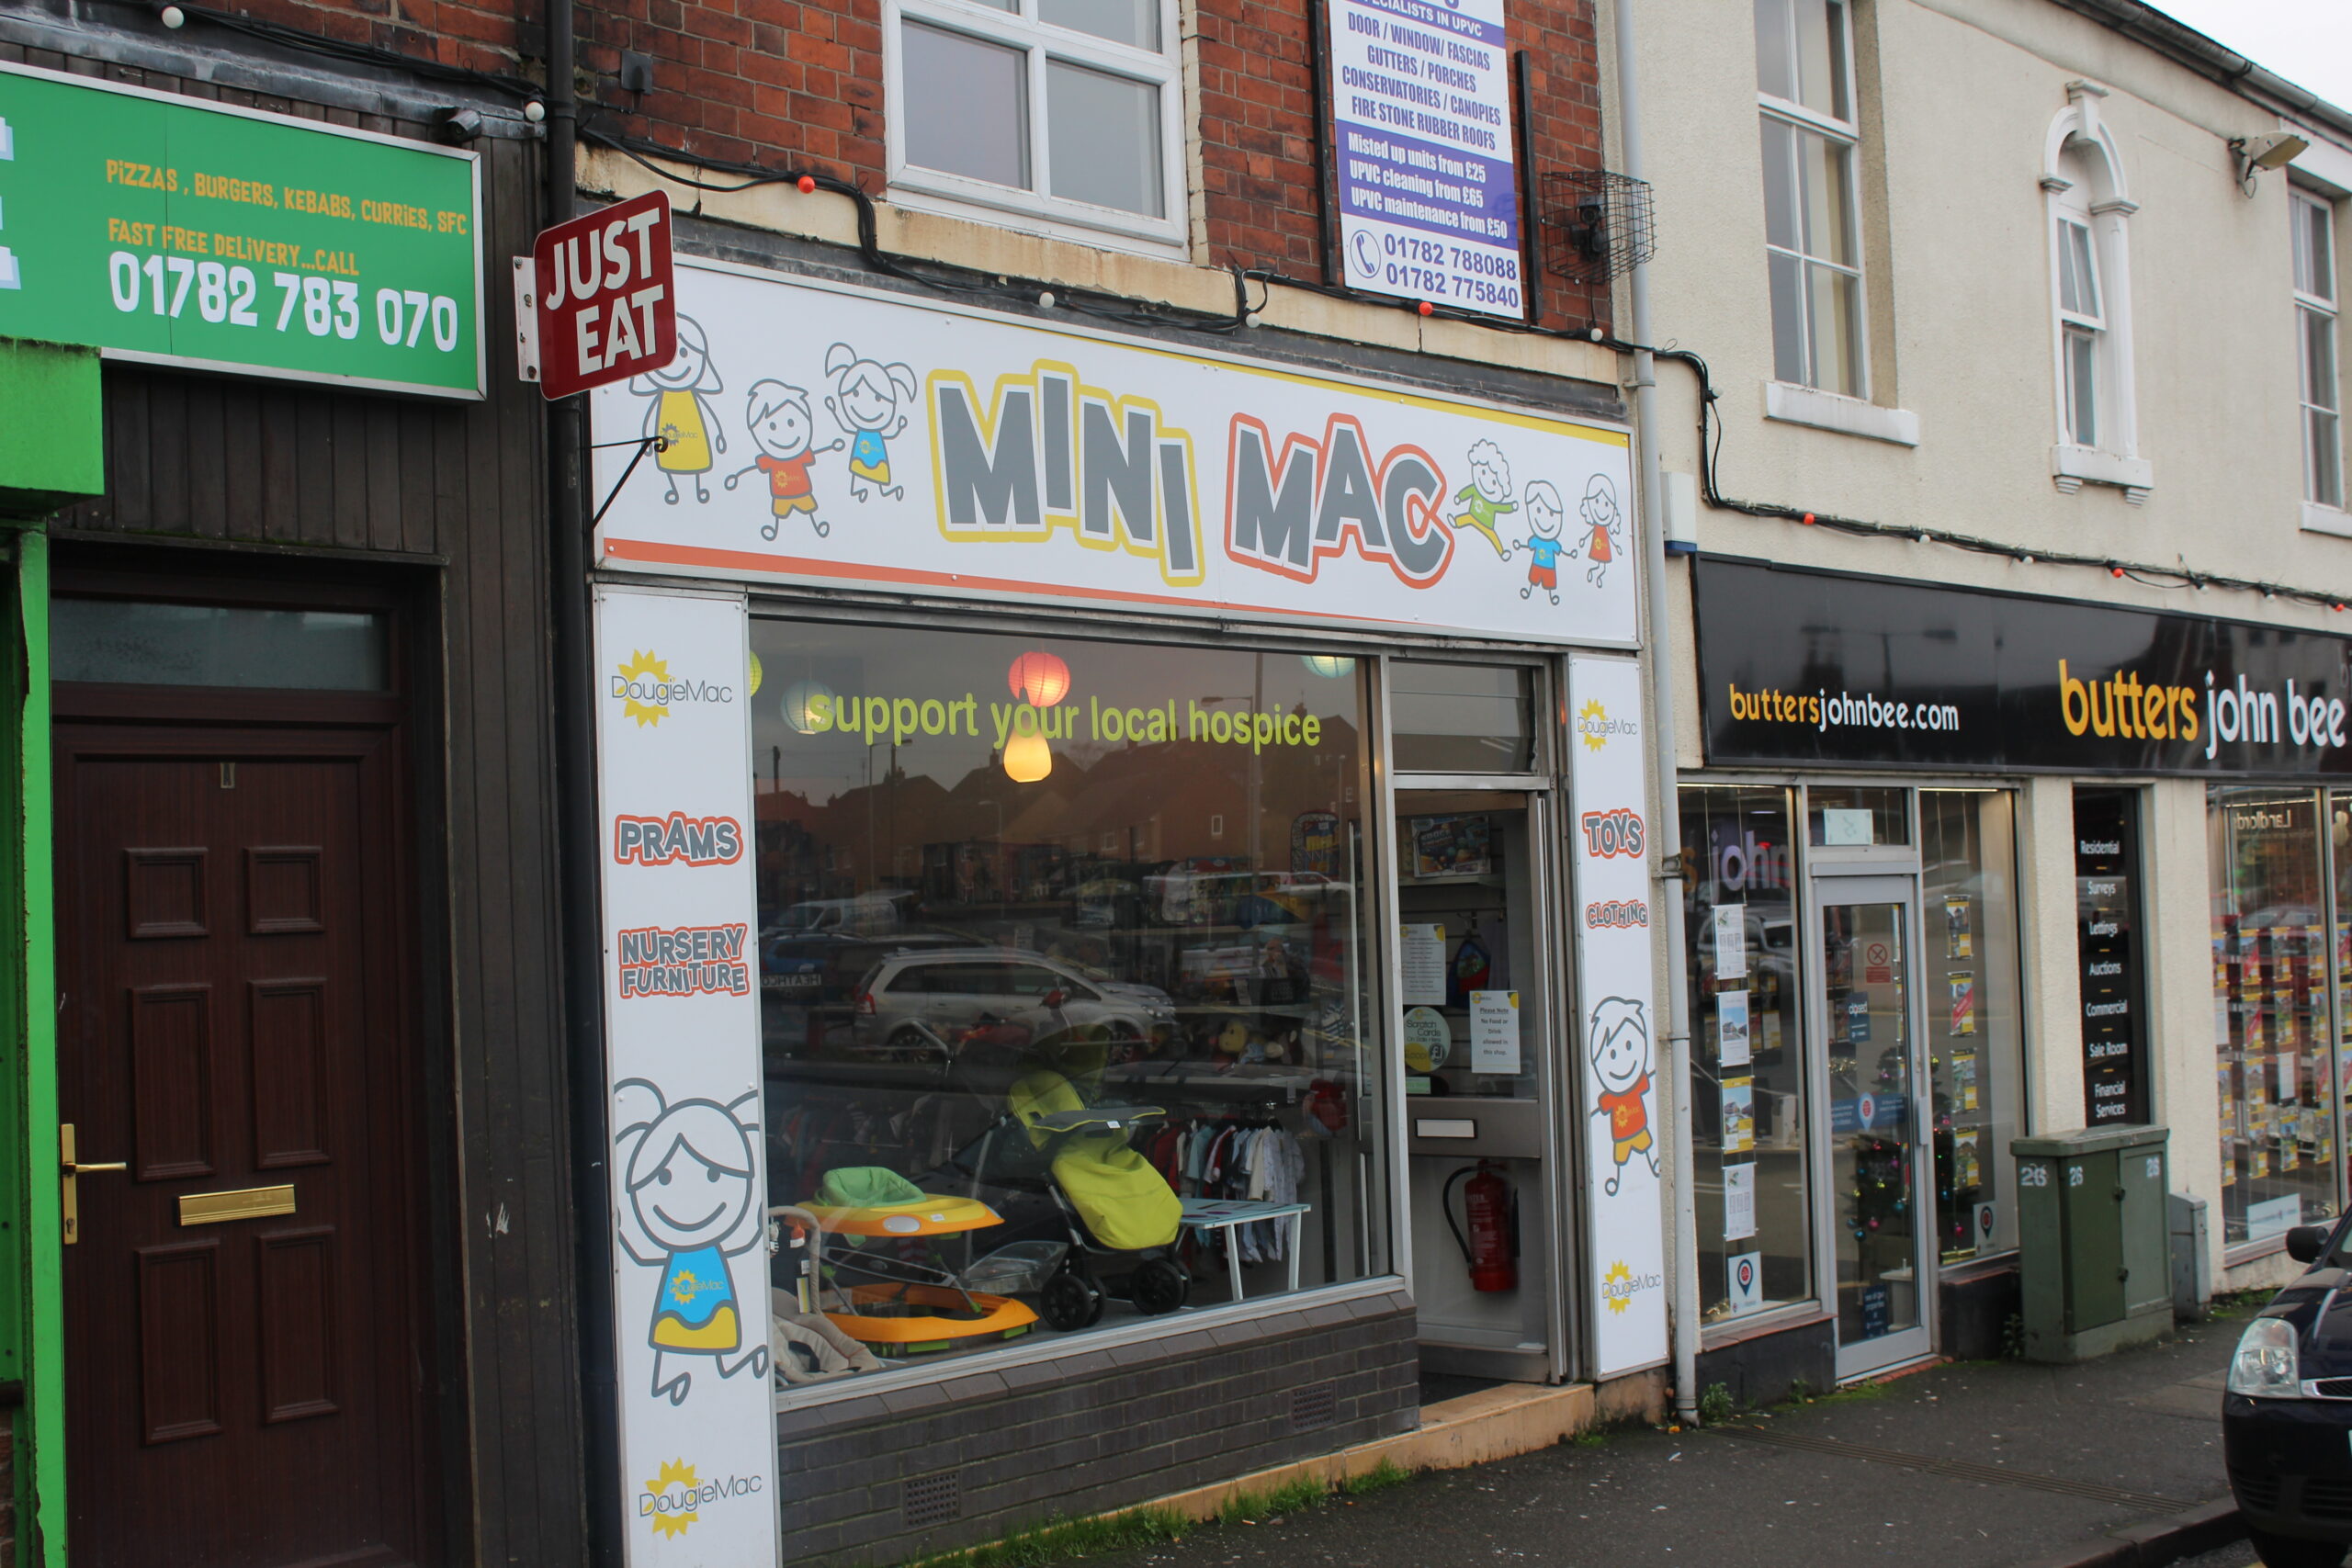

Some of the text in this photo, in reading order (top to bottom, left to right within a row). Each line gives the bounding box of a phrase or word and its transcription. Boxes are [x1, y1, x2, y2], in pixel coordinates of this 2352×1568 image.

[1348, 12, 1380, 39] DOOR
[1447, 41, 1490, 71] FASCIAS
[1437, 10, 1449, 27] IN
[1452, 16, 1482, 37] UPVC
[1367, 45, 1418, 75] GUTTERS
[1428, 62, 1476, 93] PORCHES
[1342, 66, 1441, 109] CONSERVATORIES
[1450, 95, 1501, 127] CANOPIES
[1351, 96, 1496, 151] FIRE STONE RUBBER ROOFS
[1348, 132, 1486, 184] Misted up units from £25
[194, 172, 278, 209] BURGERS,
[284, 186, 356, 220] KEBABS,
[437, 211, 467, 235] SFC
[1349, 159, 1484, 209] UPVC cleaning from £65
[108, 218, 155, 247] FAST
[162, 226, 209, 254] FREE
[1351, 186, 1508, 240] UPVC maintenance from £50
[546, 207, 660, 310] JUST
[1385, 233, 1517, 281] 01782 788088
[109, 251, 258, 328] 01782
[274, 271, 361, 341] 783
[376, 288, 458, 353] 070
[1386, 263, 1519, 309] 01782 775840
[576, 284, 663, 376] EAT
[931, 367, 1451, 581] MINI MAC
[612, 676, 734, 706] DougieMac
[1729, 682, 1960, 733] buttersjohnbee.com
[2058, 659, 2346, 760] butters john bee
[808, 693, 1321, 756] support your local hospice
[1577, 716, 1637, 738] DougieMac
[617, 814, 741, 864] PRAMS
[1583, 810, 1645, 857] TOYS
[2080, 840, 2120, 854] Residential
[1711, 829, 1791, 906] john
[2087, 881, 2116, 897] Surveys
[1586, 901, 1647, 928] CLOTHING
[2088, 920, 2118, 937] Lettings
[619, 924, 746, 965] NURSERY
[621, 962, 749, 997] FURNITURE
[2089, 961, 2121, 976] Auctions
[2086, 999, 2128, 1017] Commercial
[2089, 1042, 2128, 1057] Sale Room
[2095, 1080, 2126, 1098] Financial
[2096, 1102, 2126, 1118] Services
[2021, 1166, 2048, 1187] 26
[2069, 1166, 2084, 1187] 26
[1602, 1273, 1661, 1299] DougieMac
[639, 1473, 763, 1517] DougieMac
